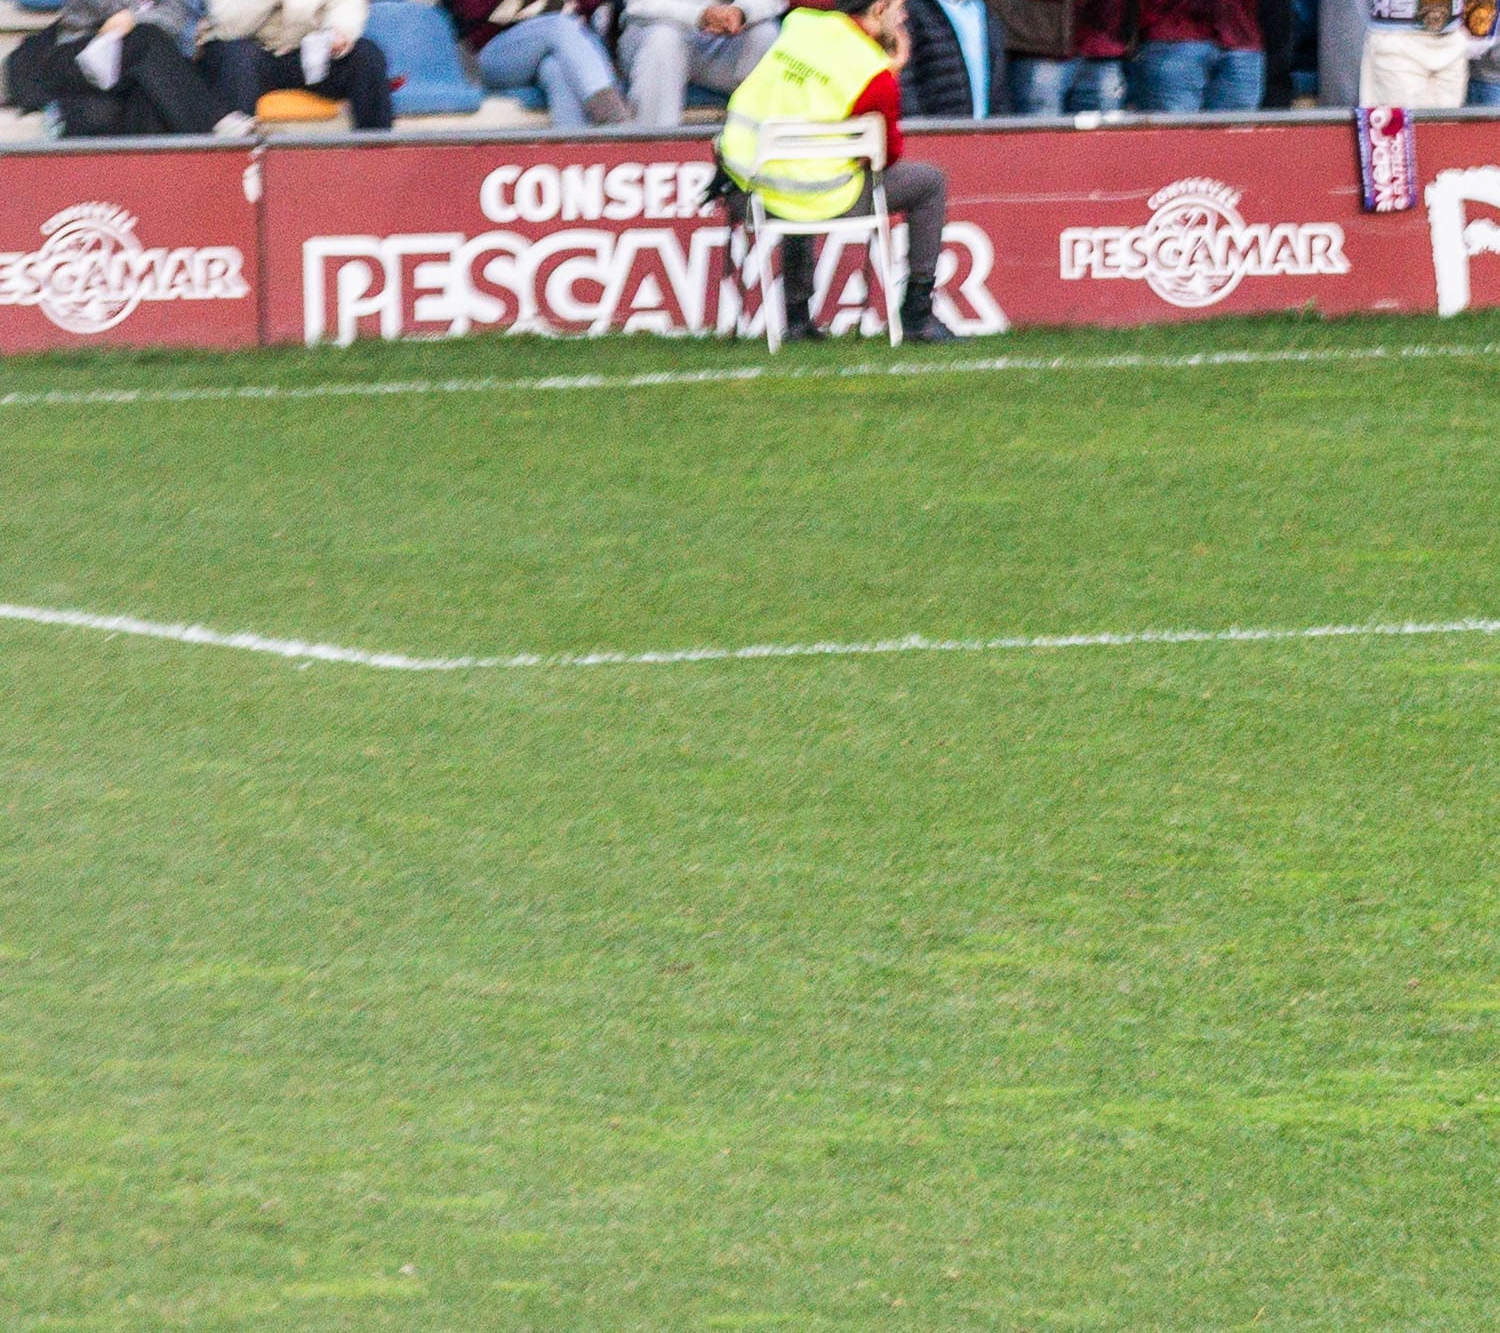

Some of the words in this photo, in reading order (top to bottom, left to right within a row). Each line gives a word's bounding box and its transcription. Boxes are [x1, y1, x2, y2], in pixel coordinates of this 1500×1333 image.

[479, 159, 718, 223] CONSER
[0, 246, 250, 306] ESCAMAR
[1059, 222, 1352, 280] PESCAMAR
